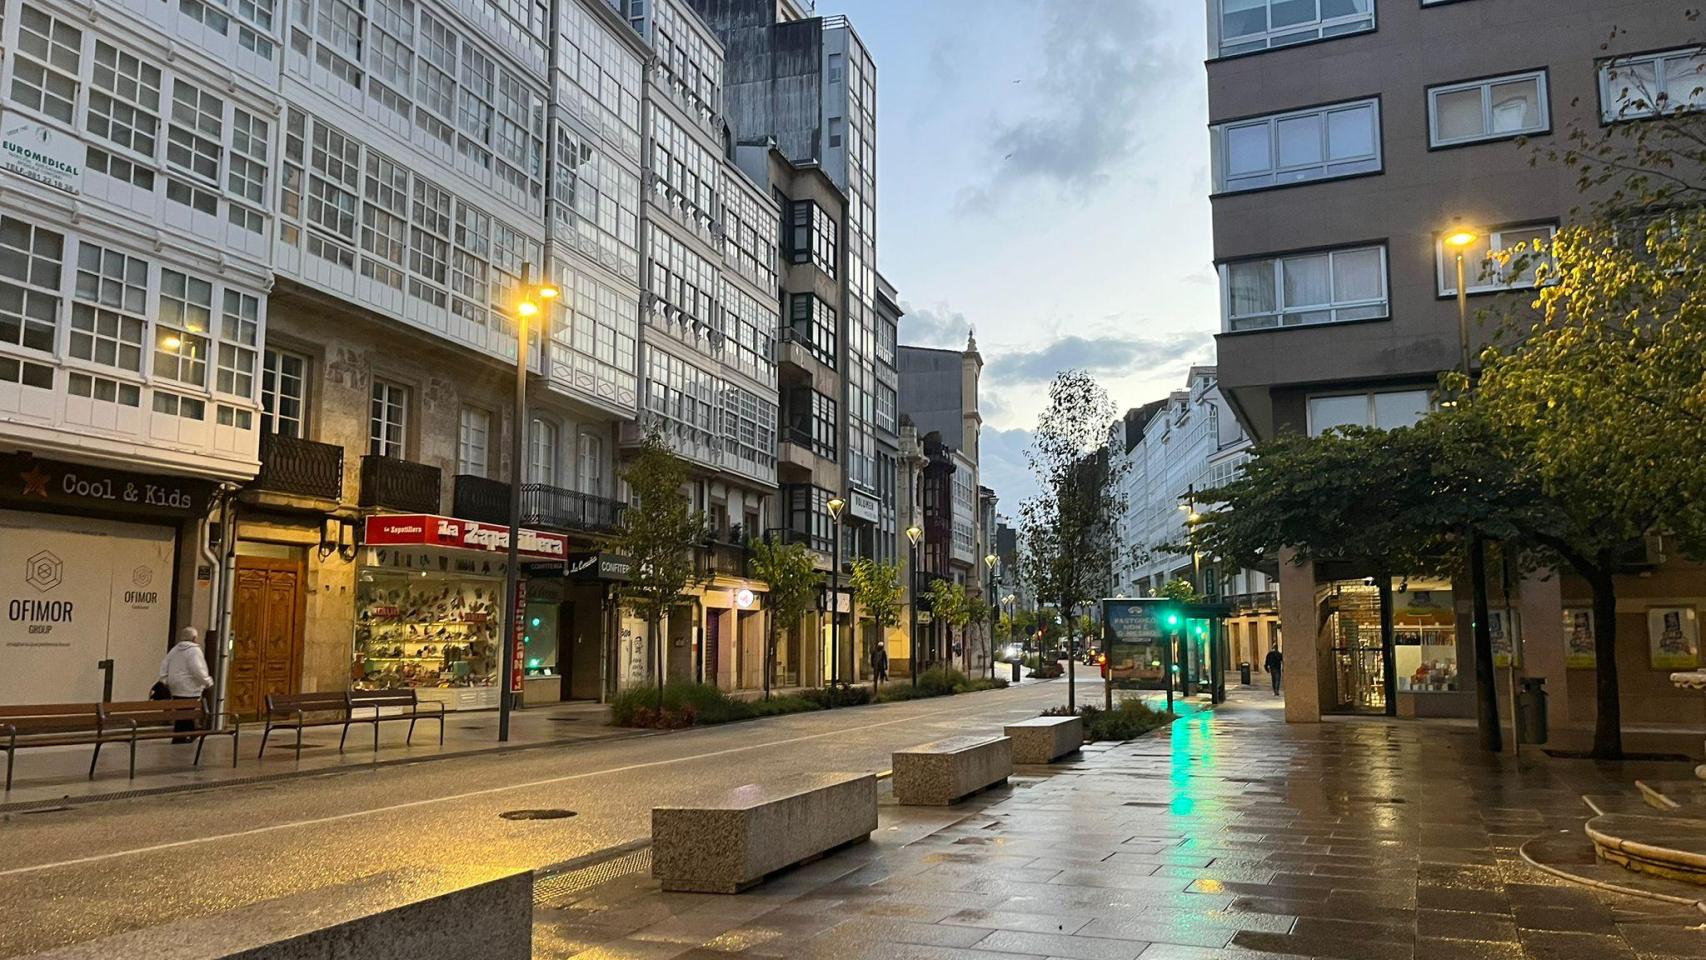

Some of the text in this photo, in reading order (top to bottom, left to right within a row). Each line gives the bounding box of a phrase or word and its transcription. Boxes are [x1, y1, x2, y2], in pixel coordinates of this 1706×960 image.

[3, 141, 79, 176] EUROMEDICAL
[63, 473, 191, 509] Cool & Kids
[437, 520, 562, 554] La Zapaillera
[8, 599, 73, 622] OFIMOR
[123, 591, 157, 603] OFIMOR
[28, 624, 52, 634] GROUP
